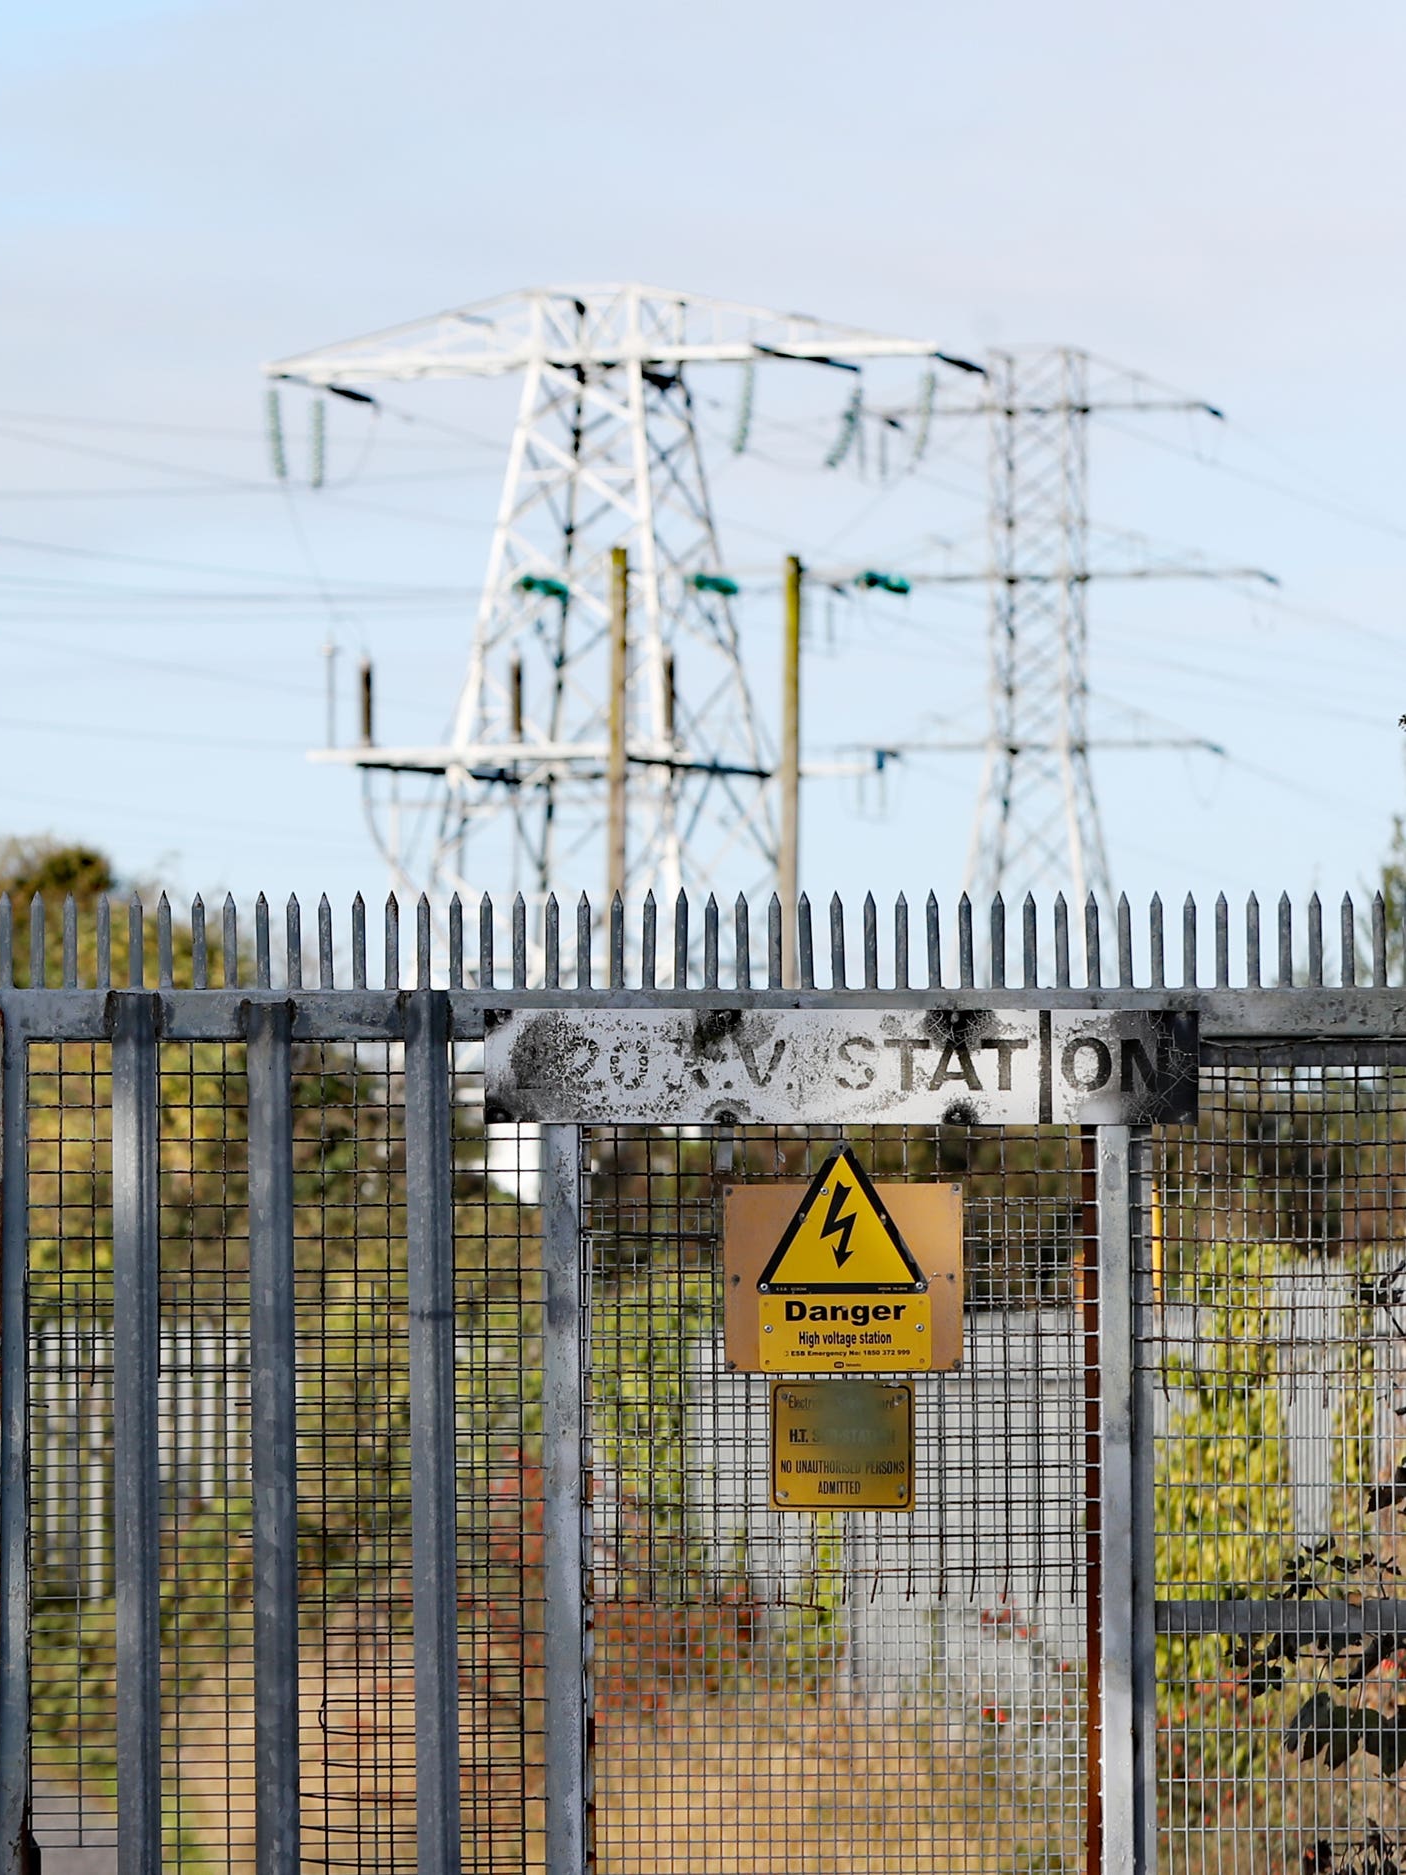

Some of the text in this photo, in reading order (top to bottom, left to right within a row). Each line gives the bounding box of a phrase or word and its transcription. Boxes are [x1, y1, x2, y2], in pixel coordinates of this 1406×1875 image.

[785, 1301, 907, 1326] Danger
[799, 1331, 892, 1348] High voltage station
[807, 1350, 847, 1358] Emergency
[789, 1429, 809, 1443] H.T.
[780, 1460, 905, 1475] NO UNAUTHORISED PERSONS
[817, 1481, 861, 1495] ADMITTED
